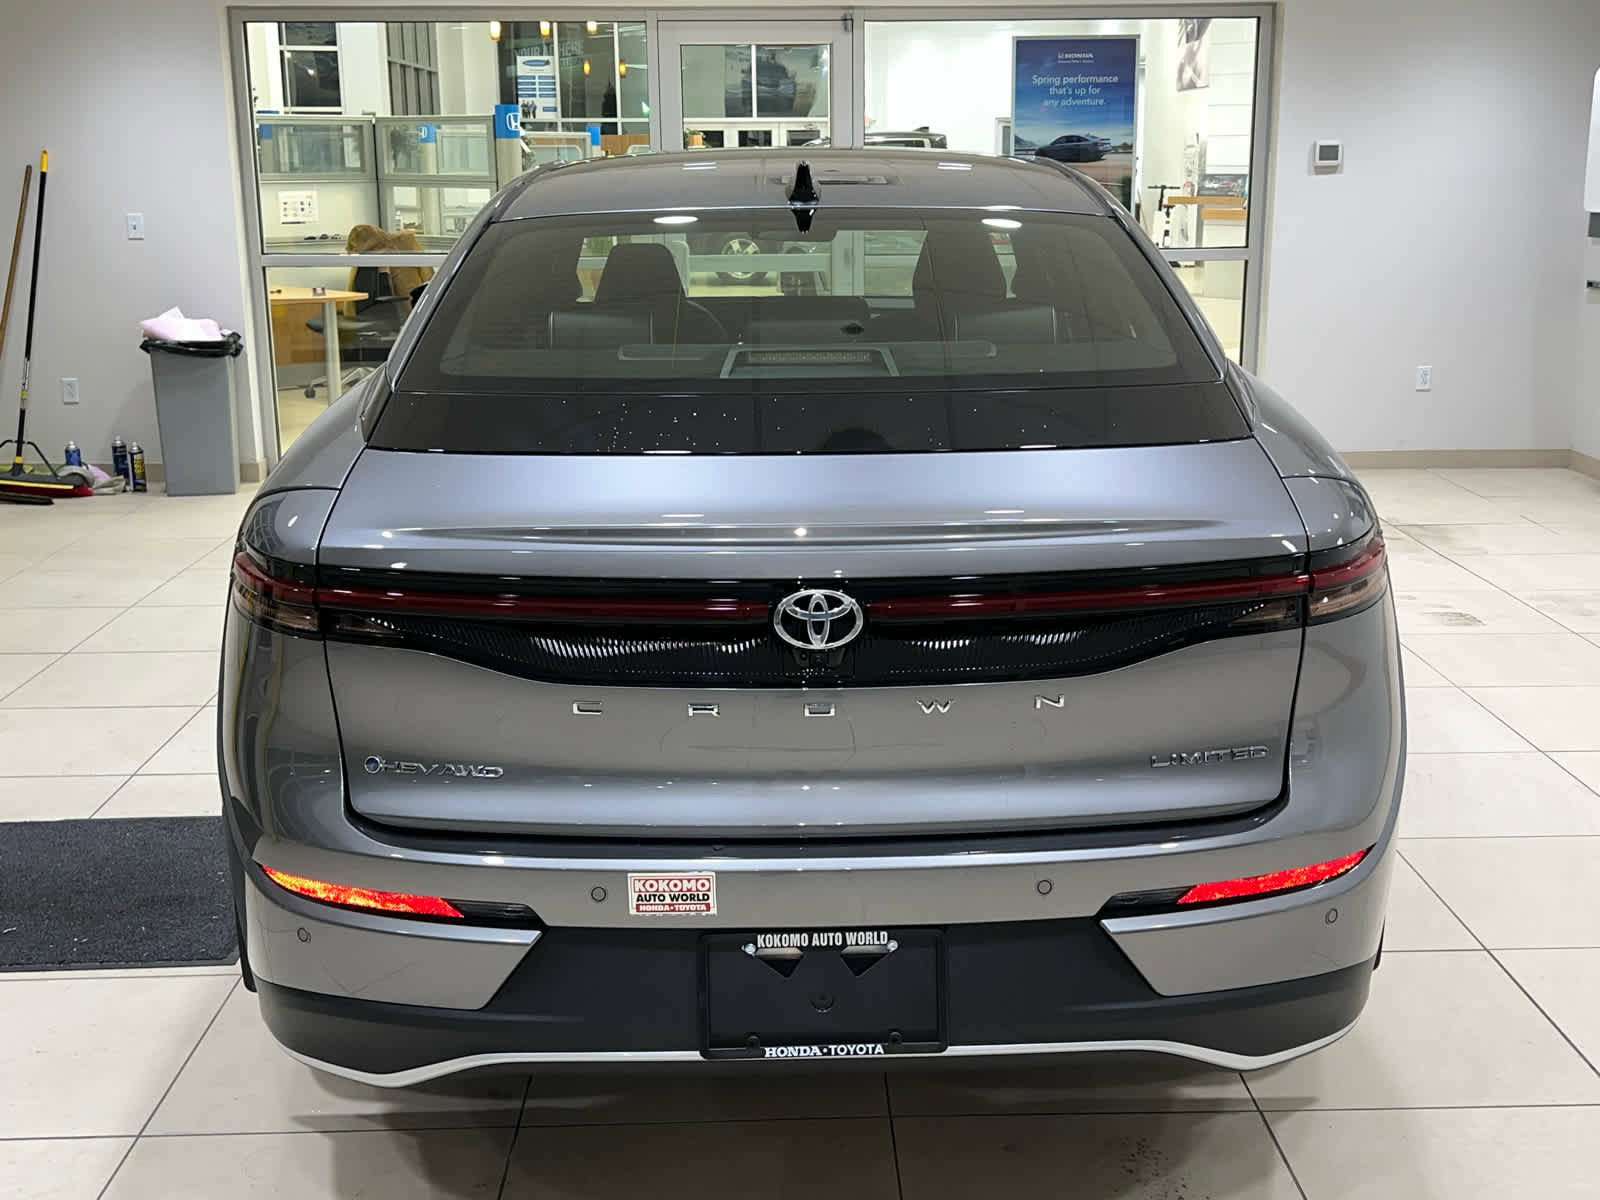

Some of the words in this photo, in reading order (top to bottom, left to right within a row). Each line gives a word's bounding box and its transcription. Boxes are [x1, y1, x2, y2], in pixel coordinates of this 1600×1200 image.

[1032, 74, 1060, 86] Spring
[1063, 74, 1119, 85] performance
[1049, 86, 1072, 95] that's
[1075, 88, 1086, 96] up
[1089, 86, 1101, 95] for
[1151, 746, 1269, 768] LIMITED
[439, 763, 504, 778] AWD
[634, 879, 711, 892] KOKOMO
[636, 893, 666, 903] AUTO
[669, 893, 711, 902] WORLD
[757, 933, 809, 948] KOKOMO
[811, 931, 843, 947] AUTO
[845, 930, 889, 946] WORLD
